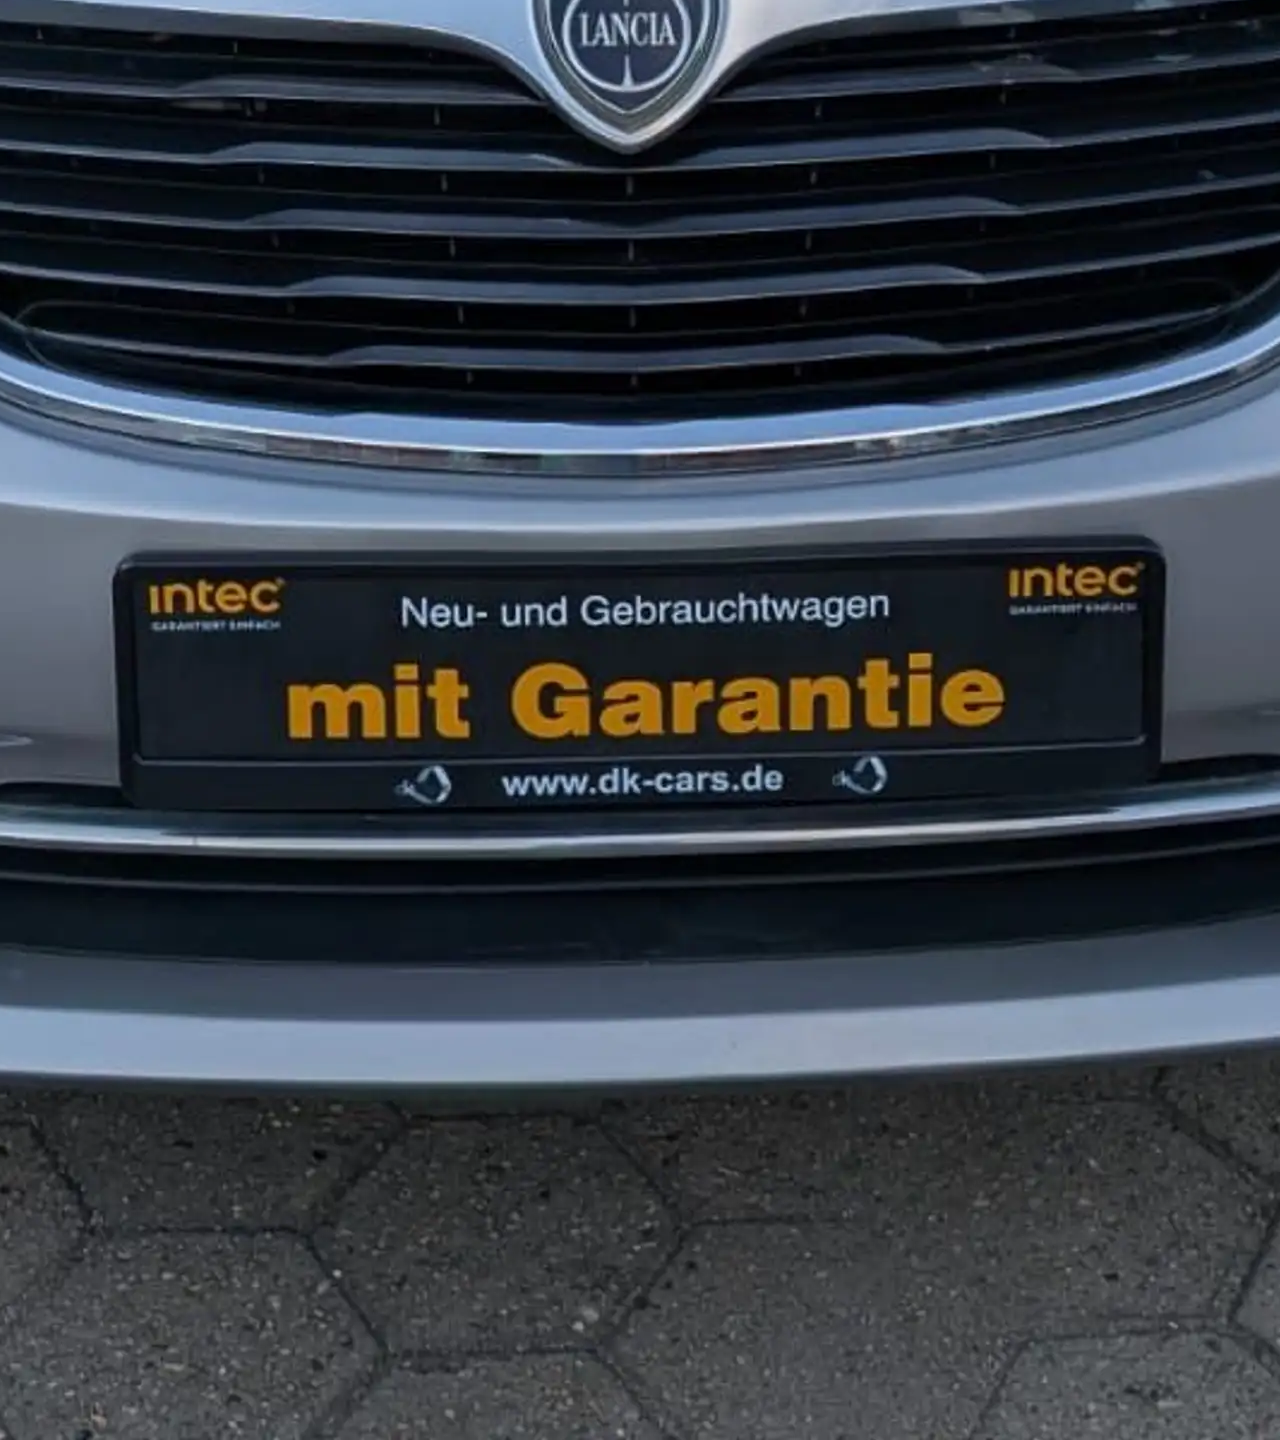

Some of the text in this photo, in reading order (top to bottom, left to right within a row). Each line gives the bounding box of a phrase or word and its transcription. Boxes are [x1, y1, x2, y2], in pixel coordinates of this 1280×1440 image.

[580, 11, 677, 48] LANCIA
[149, 579, 282, 613] intec
[1009, 561, 1140, 599] intec
[401, 591, 890, 628] Neu- und Gebrauchtwagen
[287, 653, 1005, 740] mit Garantie
[502, 764, 784, 797] www.dk-cars.de
